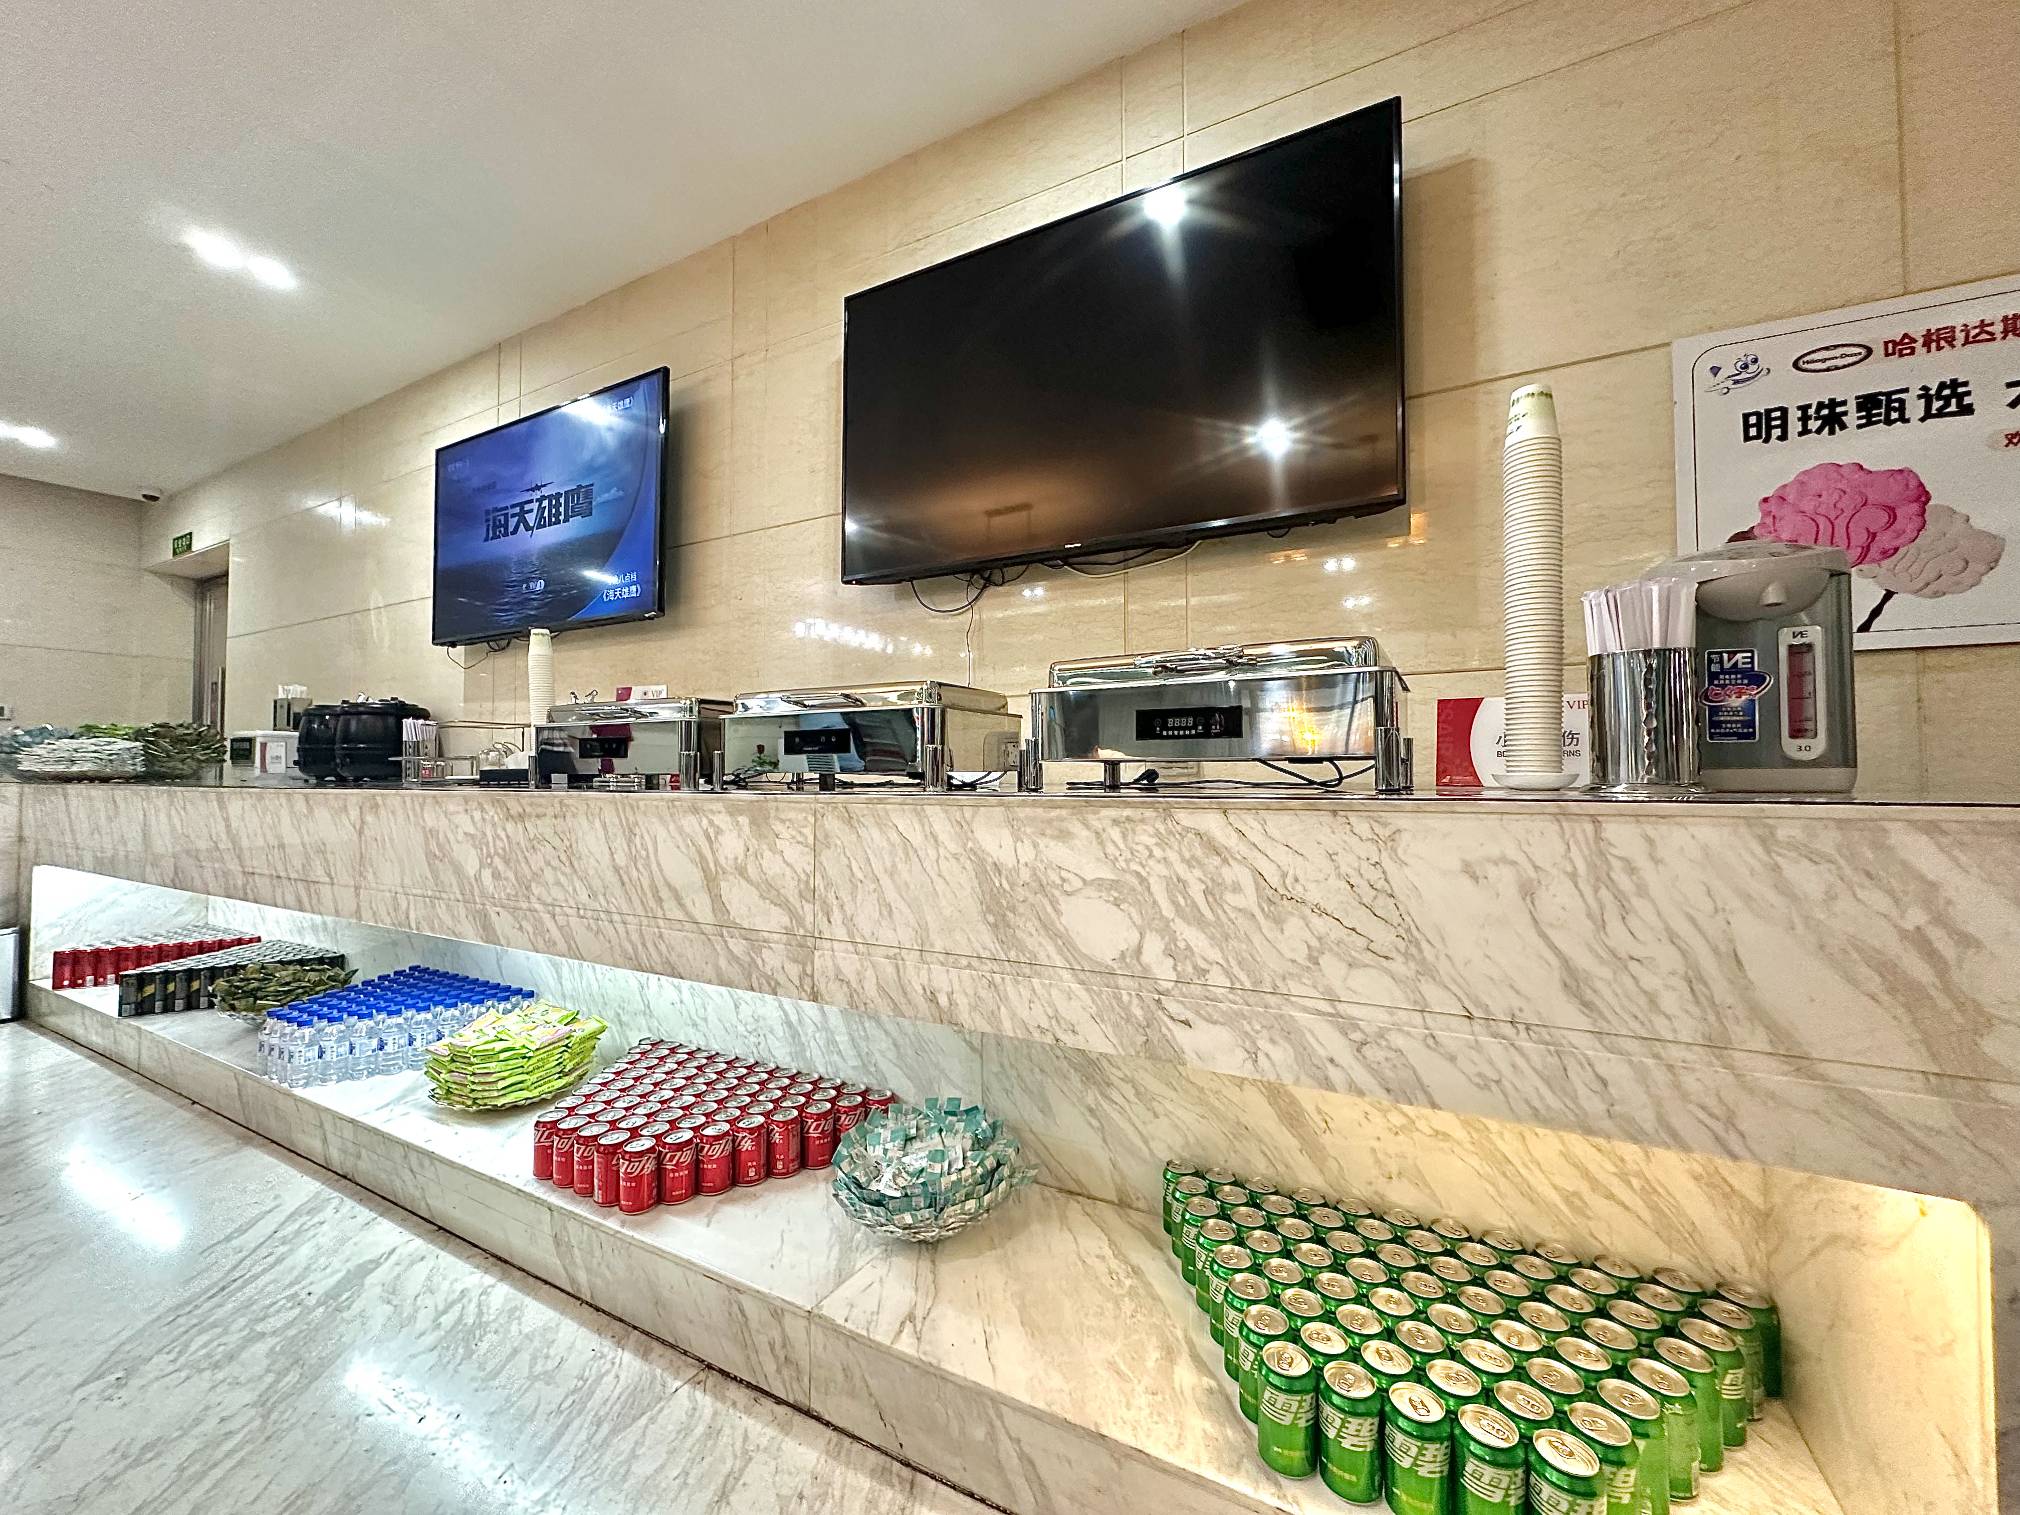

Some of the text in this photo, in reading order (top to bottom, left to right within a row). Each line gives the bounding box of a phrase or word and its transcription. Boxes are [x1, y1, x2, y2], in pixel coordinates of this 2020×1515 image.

[1742, 377, 1976, 444] 明珠甄选
[483, 482, 595, 543] 海天雄鹰
[1792, 630, 1809, 639] VE
[1722, 652, 1752, 669] VE
